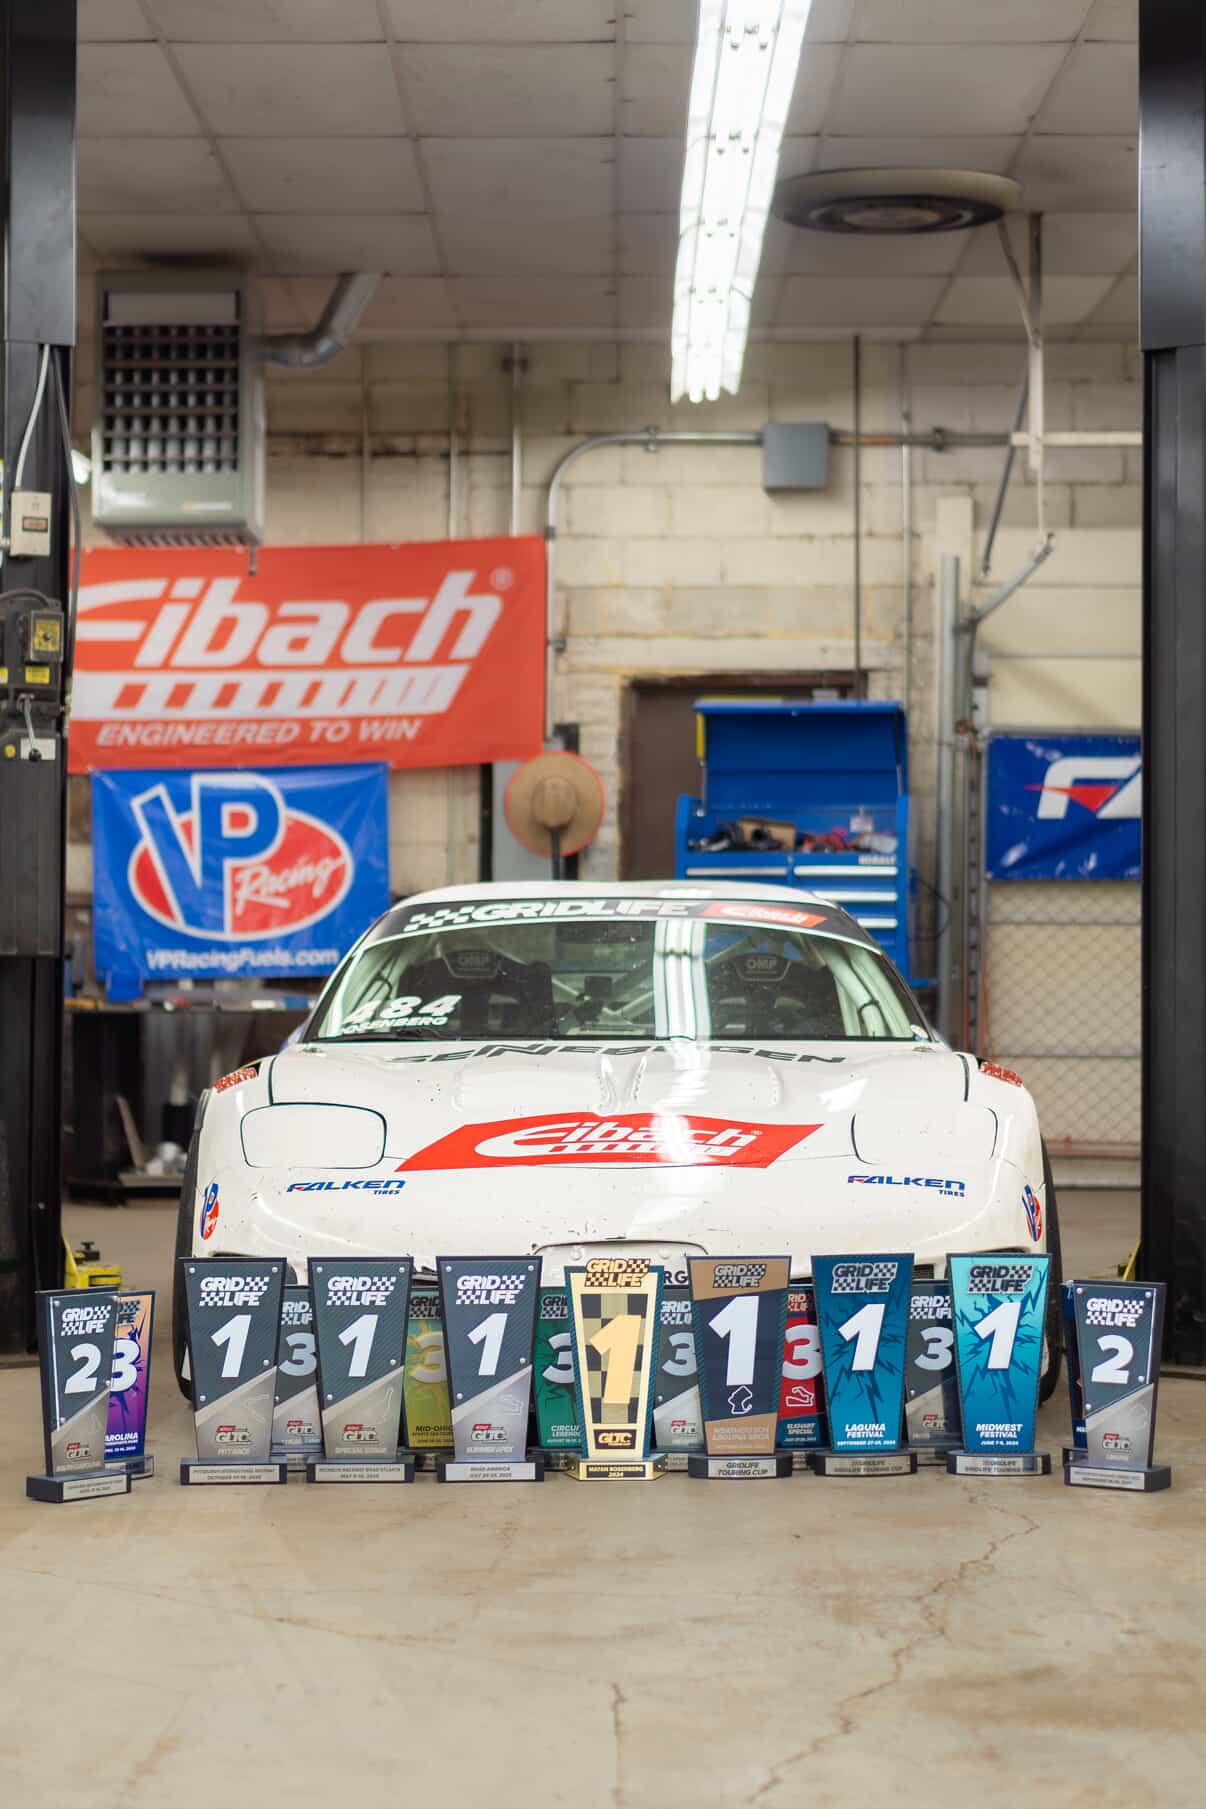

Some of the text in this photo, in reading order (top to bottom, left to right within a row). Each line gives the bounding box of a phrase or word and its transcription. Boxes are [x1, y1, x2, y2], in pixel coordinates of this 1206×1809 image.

[75, 569, 502, 669] Eibach
[96, 718, 423, 746] ENGINEERED TO WIN
[130, 772, 287, 933] VP
[233, 852, 347, 916] Racing
[470, 900, 701, 921] GRIDLIFE
[146, 946, 340, 972] VPRacingFuels.com
[344, 994, 462, 1023] 484
[286, 1179, 407, 1193] FALKEN
[847, 1175, 966, 1191] FALKEN
[938, 1189, 966, 1198] TIRES
[586, 1259, 628, 1274] GRID
[714, 1263, 748, 1276] GRID
[833, 1263, 874, 1278] GRID
[969, 1265, 1009, 1279] GRID
[199, 1276, 246, 1292] GRID
[327, 1276, 373, 1291] GRID
[456, 1275, 501, 1290] GRID
[606, 1273, 647, 1287] LIFE
[731, 1276, 762, 1288] LIFE
[854, 1278, 891, 1291] LIFE
[990, 1279, 1027, 1292] LIFE
[222, 1291, 265, 1307] LIFE
[349, 1291, 391, 1306] LIFE
[479, 1290, 520, 1305] LIFE
[787, 1293, 807, 1303] RID
[910, 1296, 945, 1308] GRID
[1086, 1297, 1124, 1313] GRID
[61, 1306, 94, 1322] GRID
[282, 1301, 311, 1313] RID
[293, 1313, 313, 1325] LIF
[1105, 1312, 1140, 1328] LIFE
[77, 1320, 107, 1335] LIFE
[974, 1301, 1022, 1369] 1
[467, 1312, 508, 1376] 1
[708, 1295, 760, 1387] 1
[838, 1303, 885, 1371] 1
[211, 1314, 252, 1378] 1
[338, 1314, 379, 1377] 1
[782, 1324, 821, 1380] 3
[914, 1326, 954, 1371] 3
[279, 1332, 318, 1376] 3
[542, 1332, 575, 1384] 3
[590, 1314, 642, 1405] 1
[661, 1332, 697, 1377] 3
[1091, 1334, 1134, 1384] 2
[64, 1342, 102, 1394] 2
[110, 1339, 141, 1392] 3
[845, 1424, 886, 1432] LAGUNA
[847, 1431, 884, 1439] FESTIVAL
[976, 1423, 1023, 1432] MIDWEST
[979, 1431, 1018, 1439] FESTIVAL
[105, 1432, 139, 1443] AROLINA
